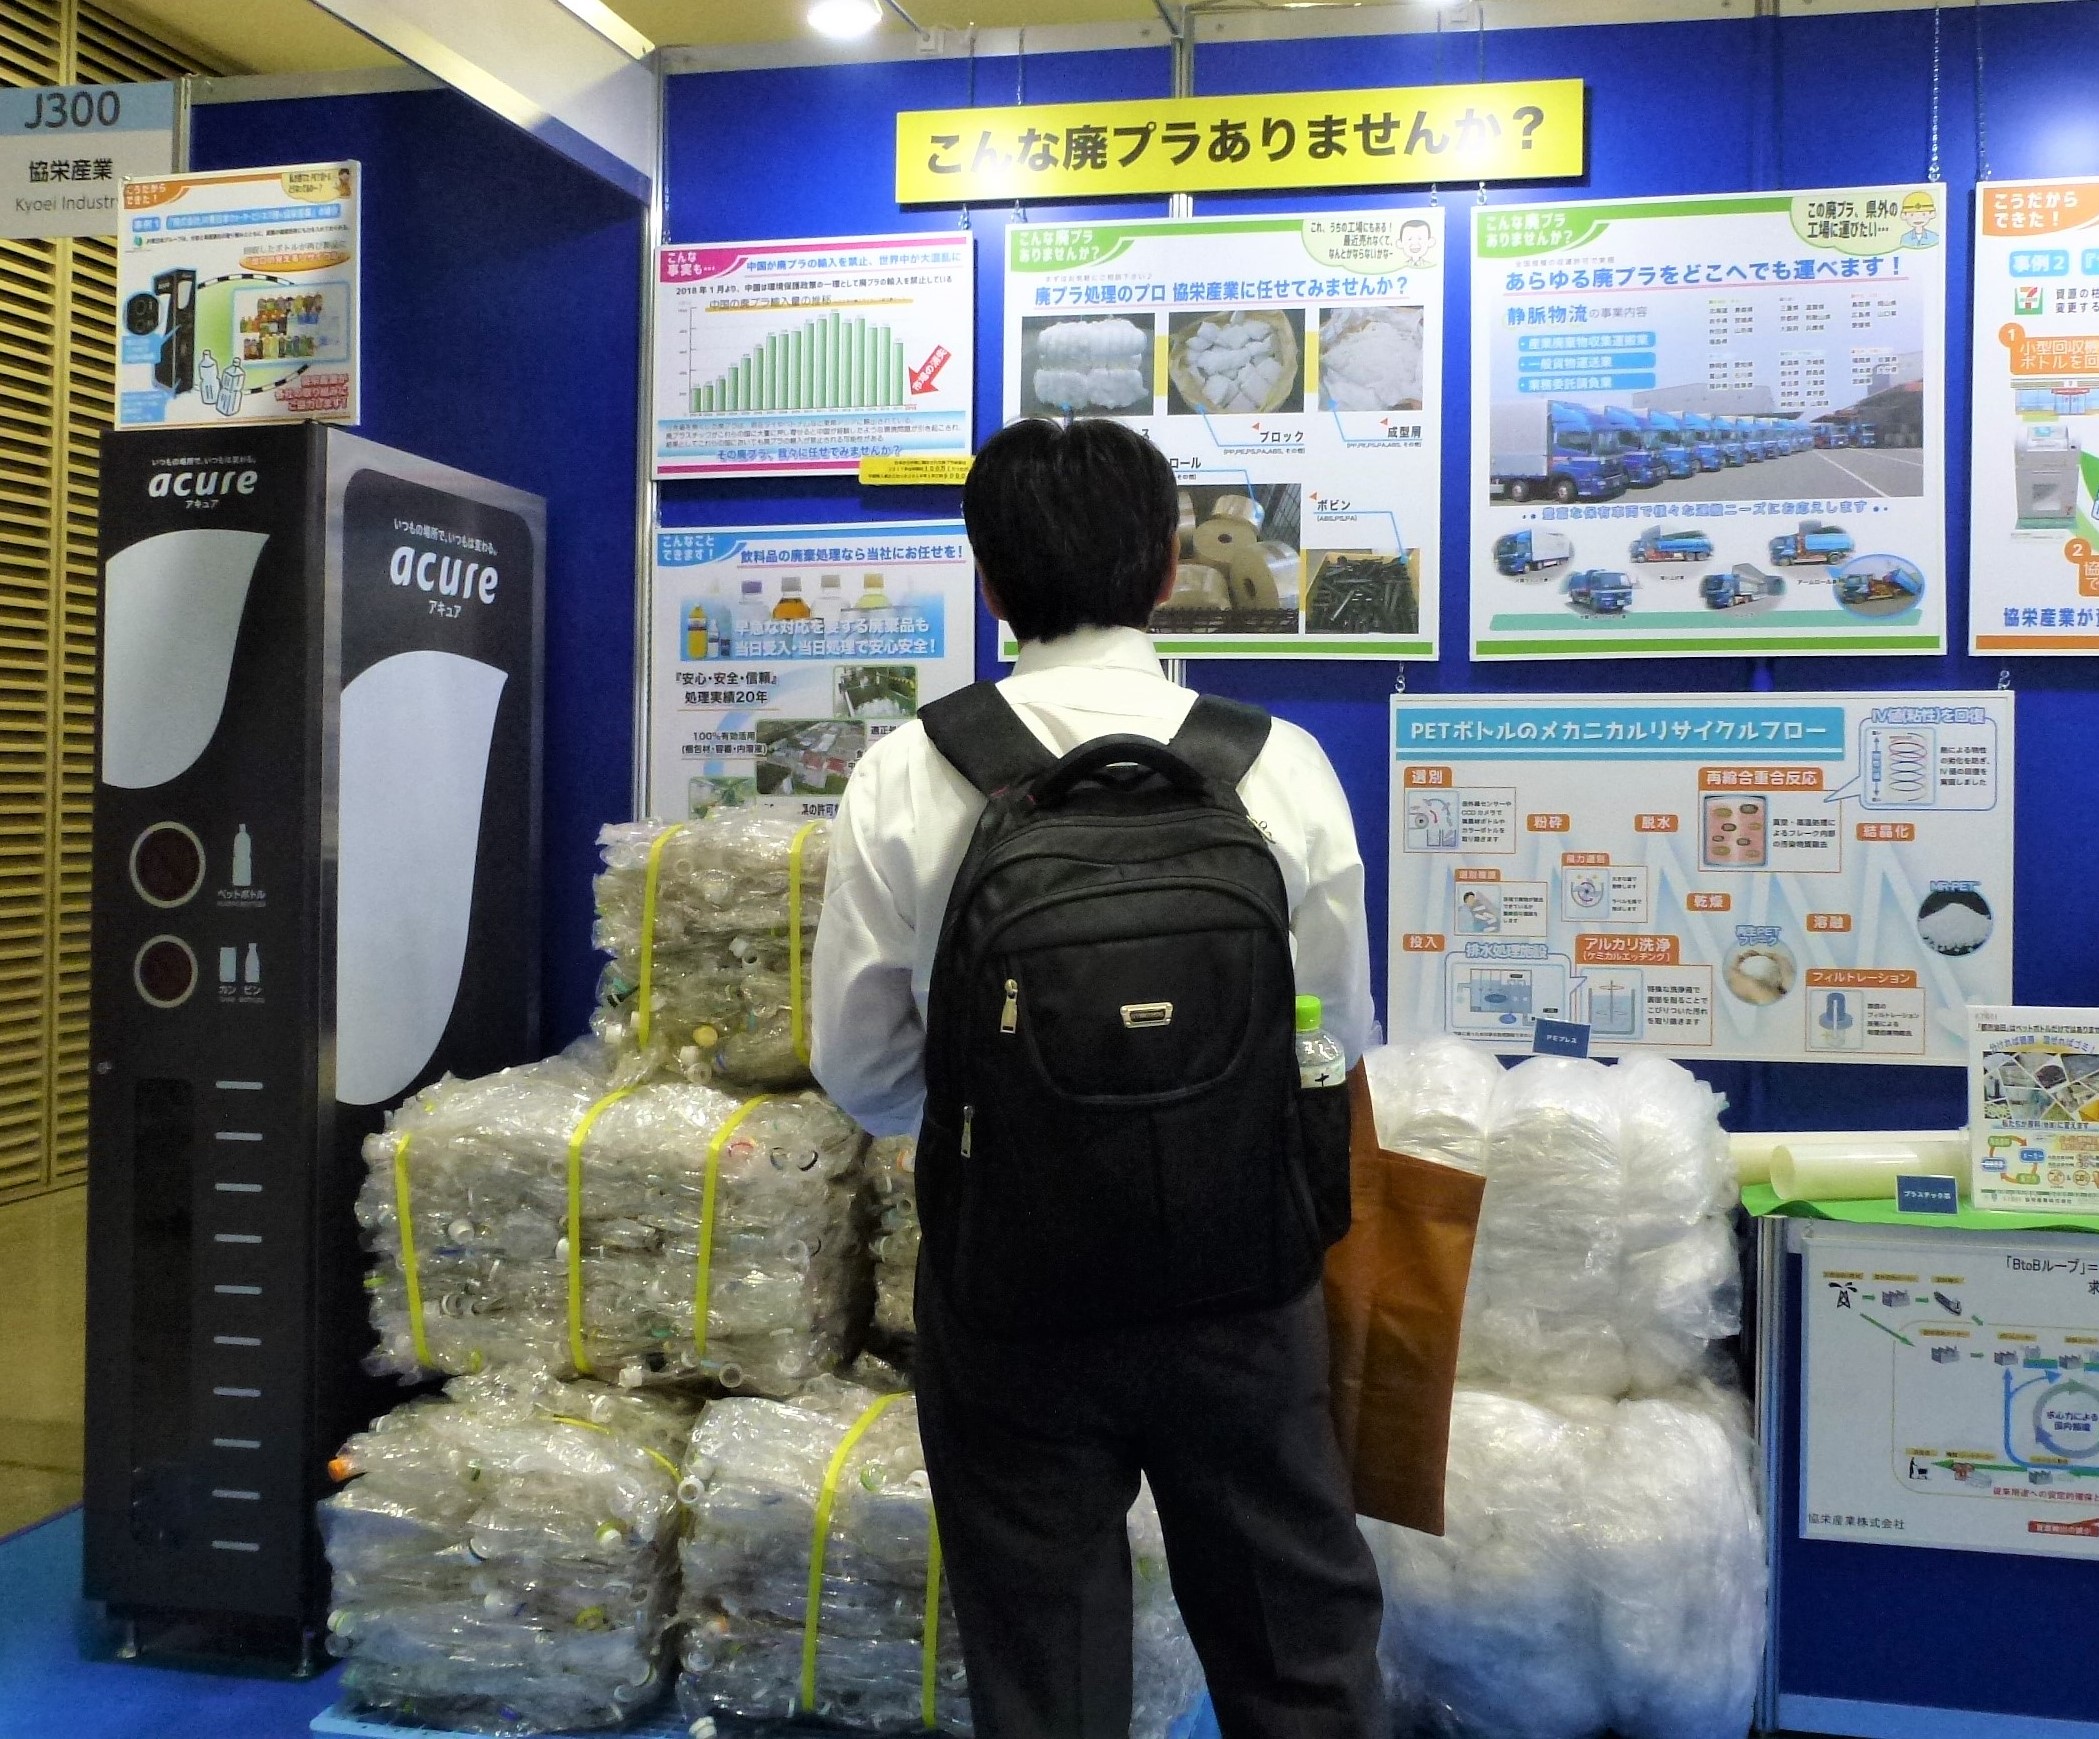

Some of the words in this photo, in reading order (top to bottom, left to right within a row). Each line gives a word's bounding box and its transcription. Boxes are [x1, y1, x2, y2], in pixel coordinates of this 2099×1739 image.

[24, 90, 121, 129] J300
[928, 105, 1545, 175] こんな廃プラありませんか？
[29, 158, 114, 184] 協栄産業
[16, 196, 57, 215] Kyoei
[1993, 191, 2079, 209] こうだから
[1993, 211, 2060, 228] できた！
[1018, 229, 1093, 247] こんな廃プラ
[1485, 229, 1573, 249] ありませんか？
[668, 251, 697, 264] こんな
[1018, 246, 1100, 262] ありませんか？
[1505, 256, 1901, 292] あらゆる廃プラをどこへでも運べます！
[1035, 283, 1166, 306] 廃プラ処理のプロ
[1172, 276, 1408, 302] 協栄産業に任せてみませんか？
[2007, 328, 2015, 341] 1
[1260, 430, 1305, 444] ブロック
[147, 467, 259, 498] acure
[185, 499, 219, 509] アキュア
[1317, 499, 1351, 511] ボビン
[663, 535, 715, 548] こんなこと
[2072, 543, 2083, 557] 2
[663, 550, 714, 561] できます！
[389, 545, 498, 605] acure
[428, 600, 462, 619] アキュア
[2004, 607, 2099, 627] 協栄産業が
[684, 690, 768, 705] 処理実績20年
[1411, 720, 1827, 741] PETボトルのメカニカルリサイクルフロー
[1641, 815, 1671, 829] 脱水
[1409, 935, 1438, 949] 投入
[1584, 937, 1671, 952] アルカリ洗浄
[1812, 971, 1911, 984] フィルトレーション
